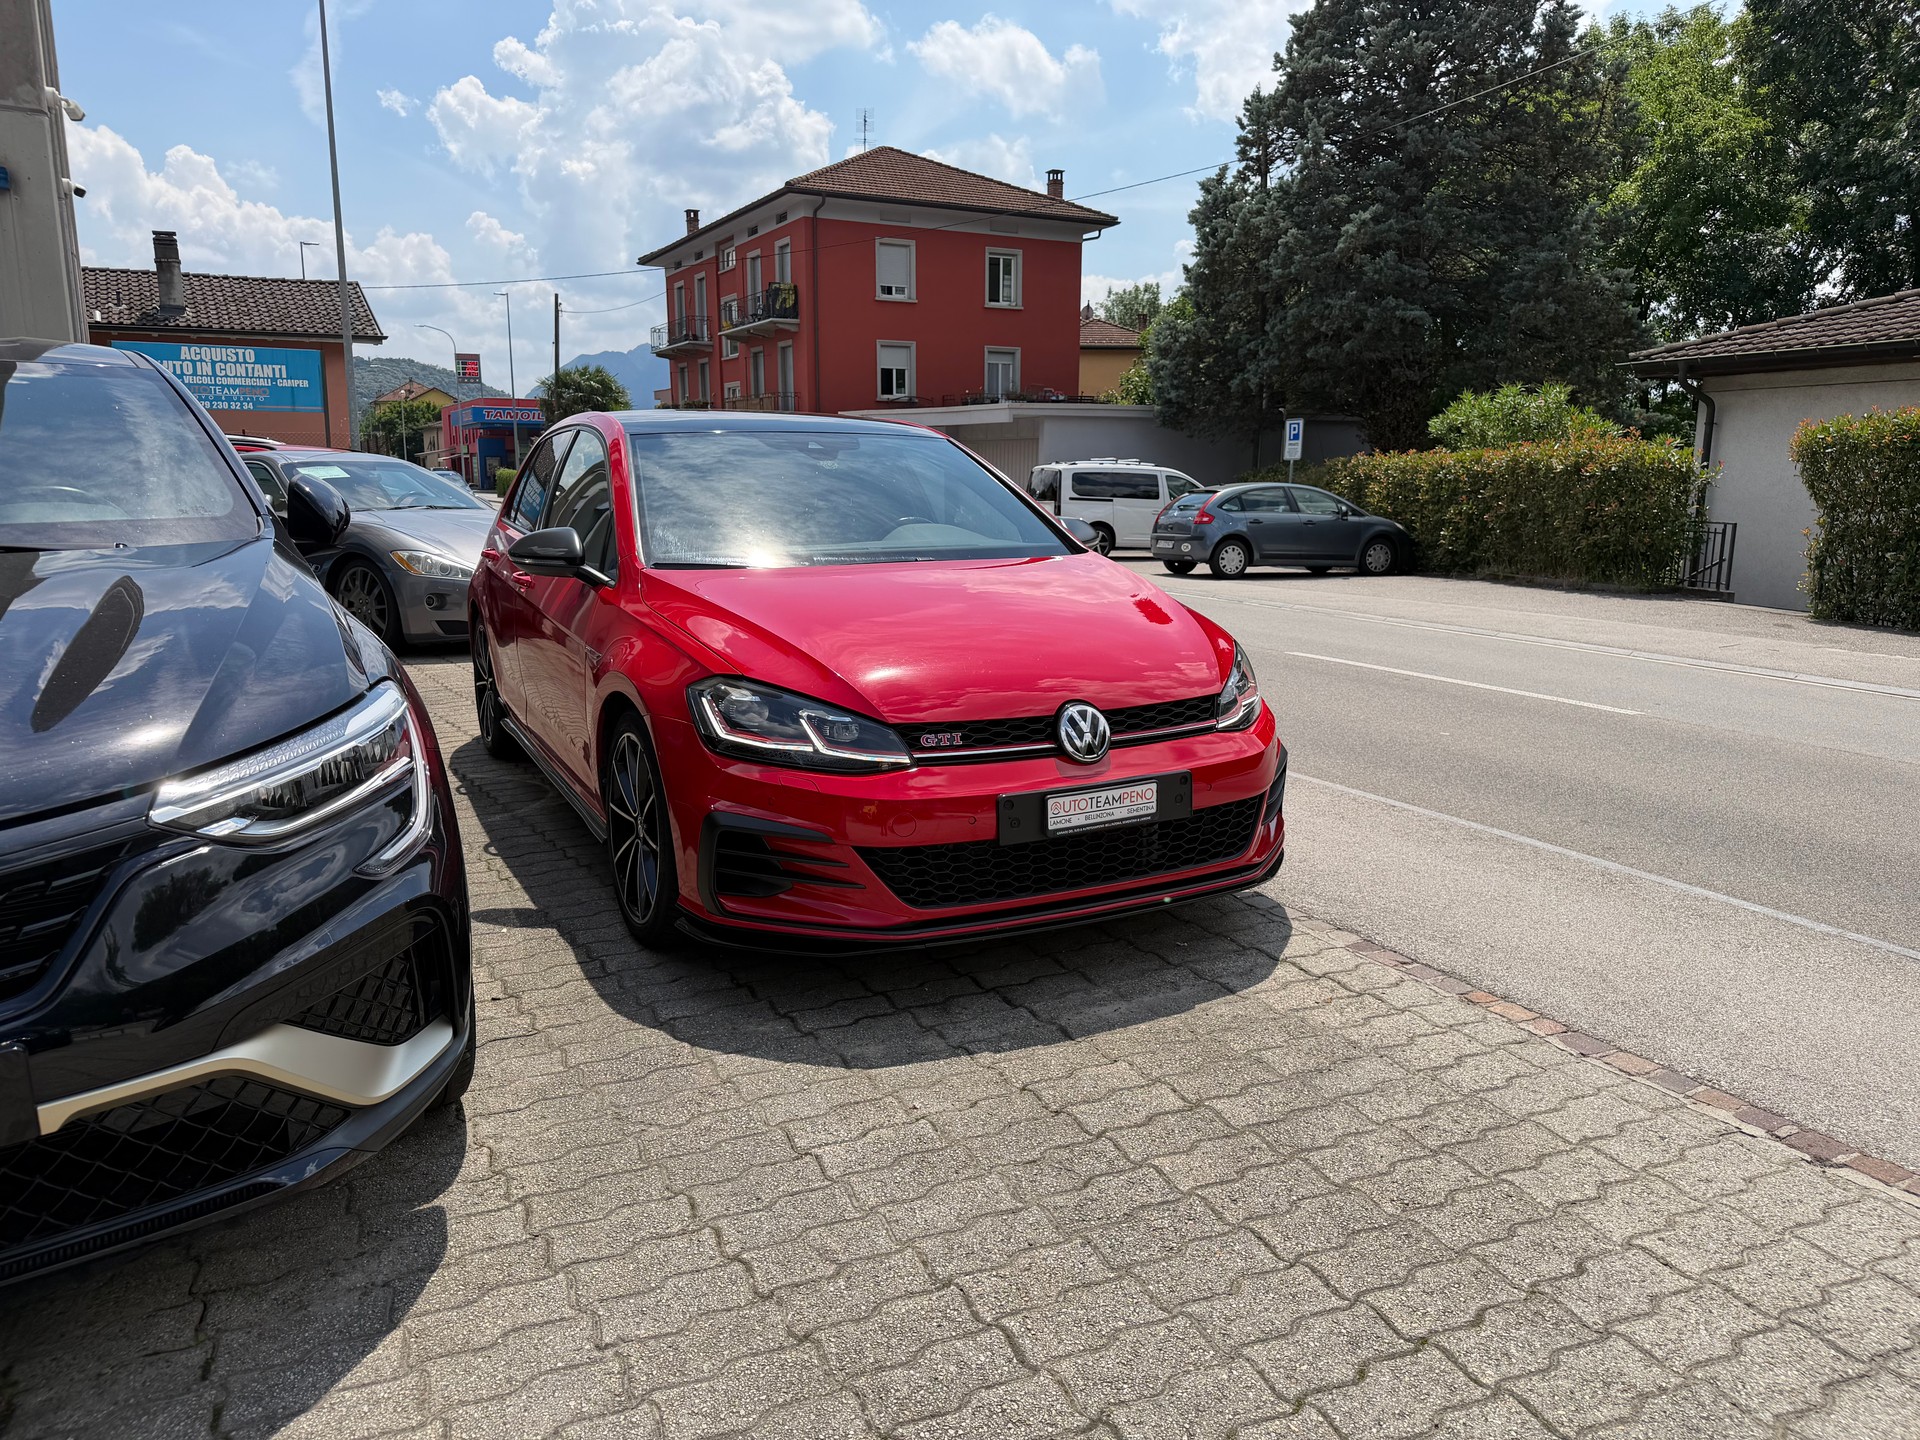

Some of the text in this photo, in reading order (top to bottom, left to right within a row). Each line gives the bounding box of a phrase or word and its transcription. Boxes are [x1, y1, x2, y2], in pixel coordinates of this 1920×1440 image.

[180, 346, 256, 363] ACQUISTO
[160, 360, 287, 378] UTO IN CONTANTI
[183, 375, 215, 384] VEICOLI
[216, 376, 271, 387] COMMERCIALI
[277, 379, 309, 388] CAMPER
[213, 401, 229, 409] 230
[230, 401, 241, 409] 32
[243, 402, 254, 410] 34
[484, 409, 546, 421] TAMOIL
[1290, 424, 1299, 440] P
[920, 732, 963, 747] GTI
[1049, 817, 1073, 827] LAMONE
[1084, 811, 1115, 822] BELLINZONA
[1126, 804, 1155, 815] SEMENTINA
